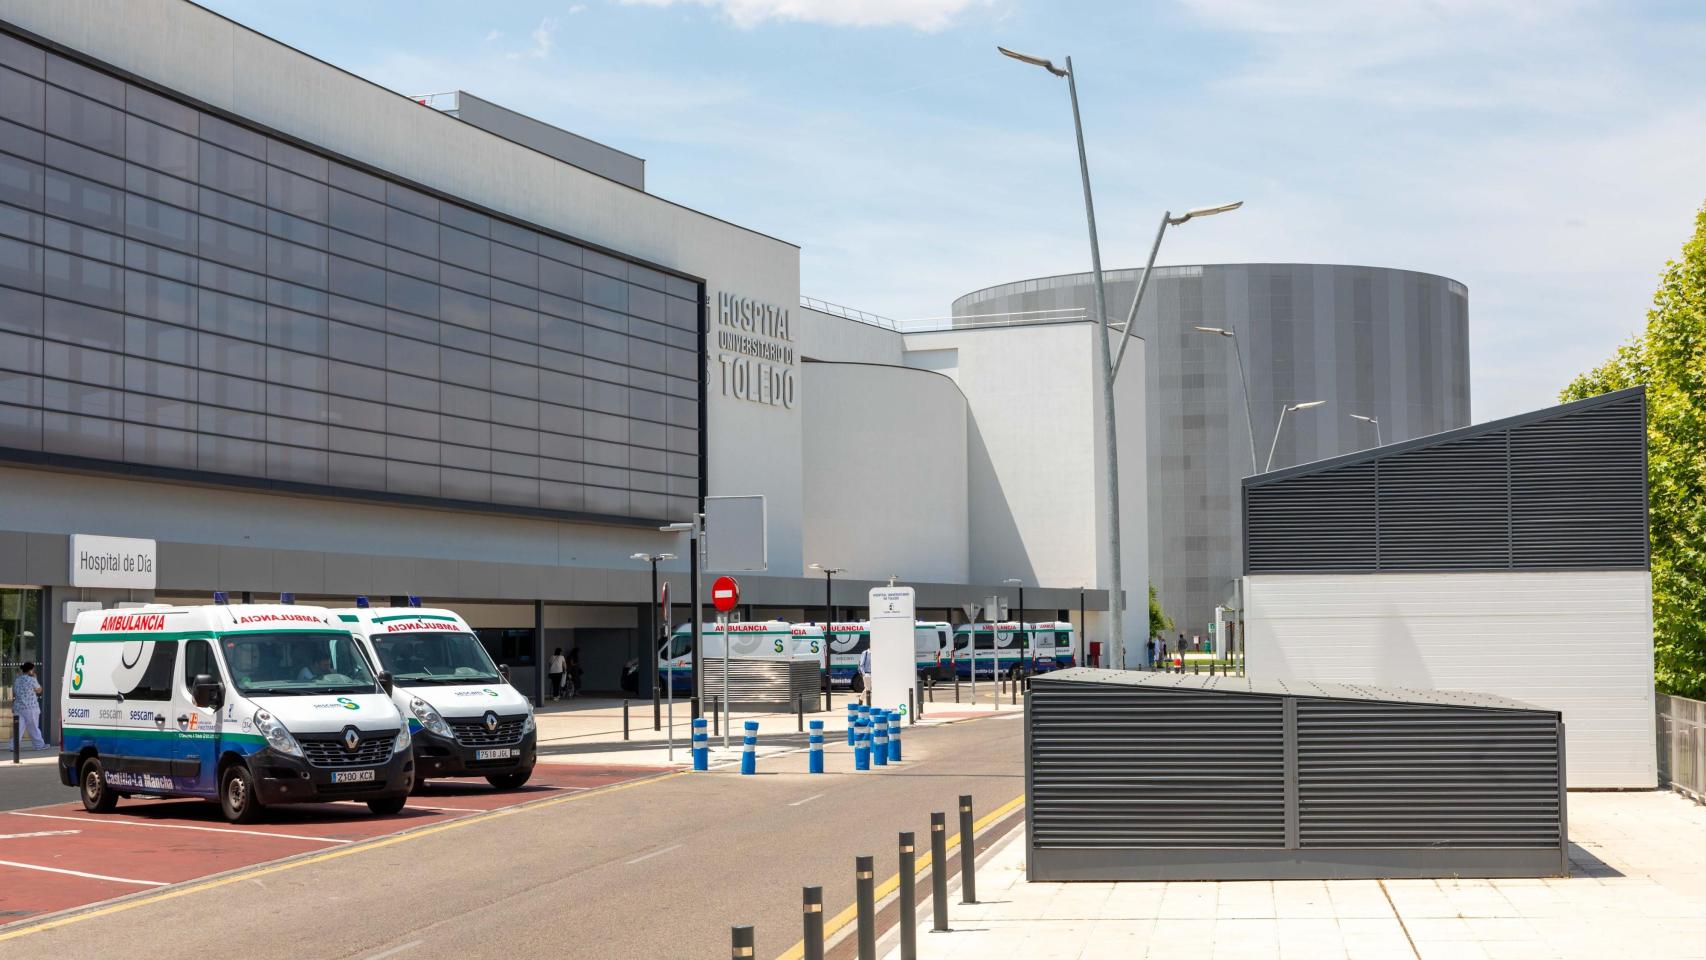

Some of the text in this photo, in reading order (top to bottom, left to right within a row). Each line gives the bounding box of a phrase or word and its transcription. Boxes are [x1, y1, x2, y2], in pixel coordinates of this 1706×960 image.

[718, 291, 793, 342] HOSPITAL
[718, 330, 782, 361] UNIVERSITARIO
[718, 353, 794, 410] TOLEDO
[80, 550, 152, 575] Hospital de Día
[100, 615, 165, 631] AMBULANCIA
[68, 707, 154, 721] sescam sescam sescam
[143, 773, 174, 790] Mancha
